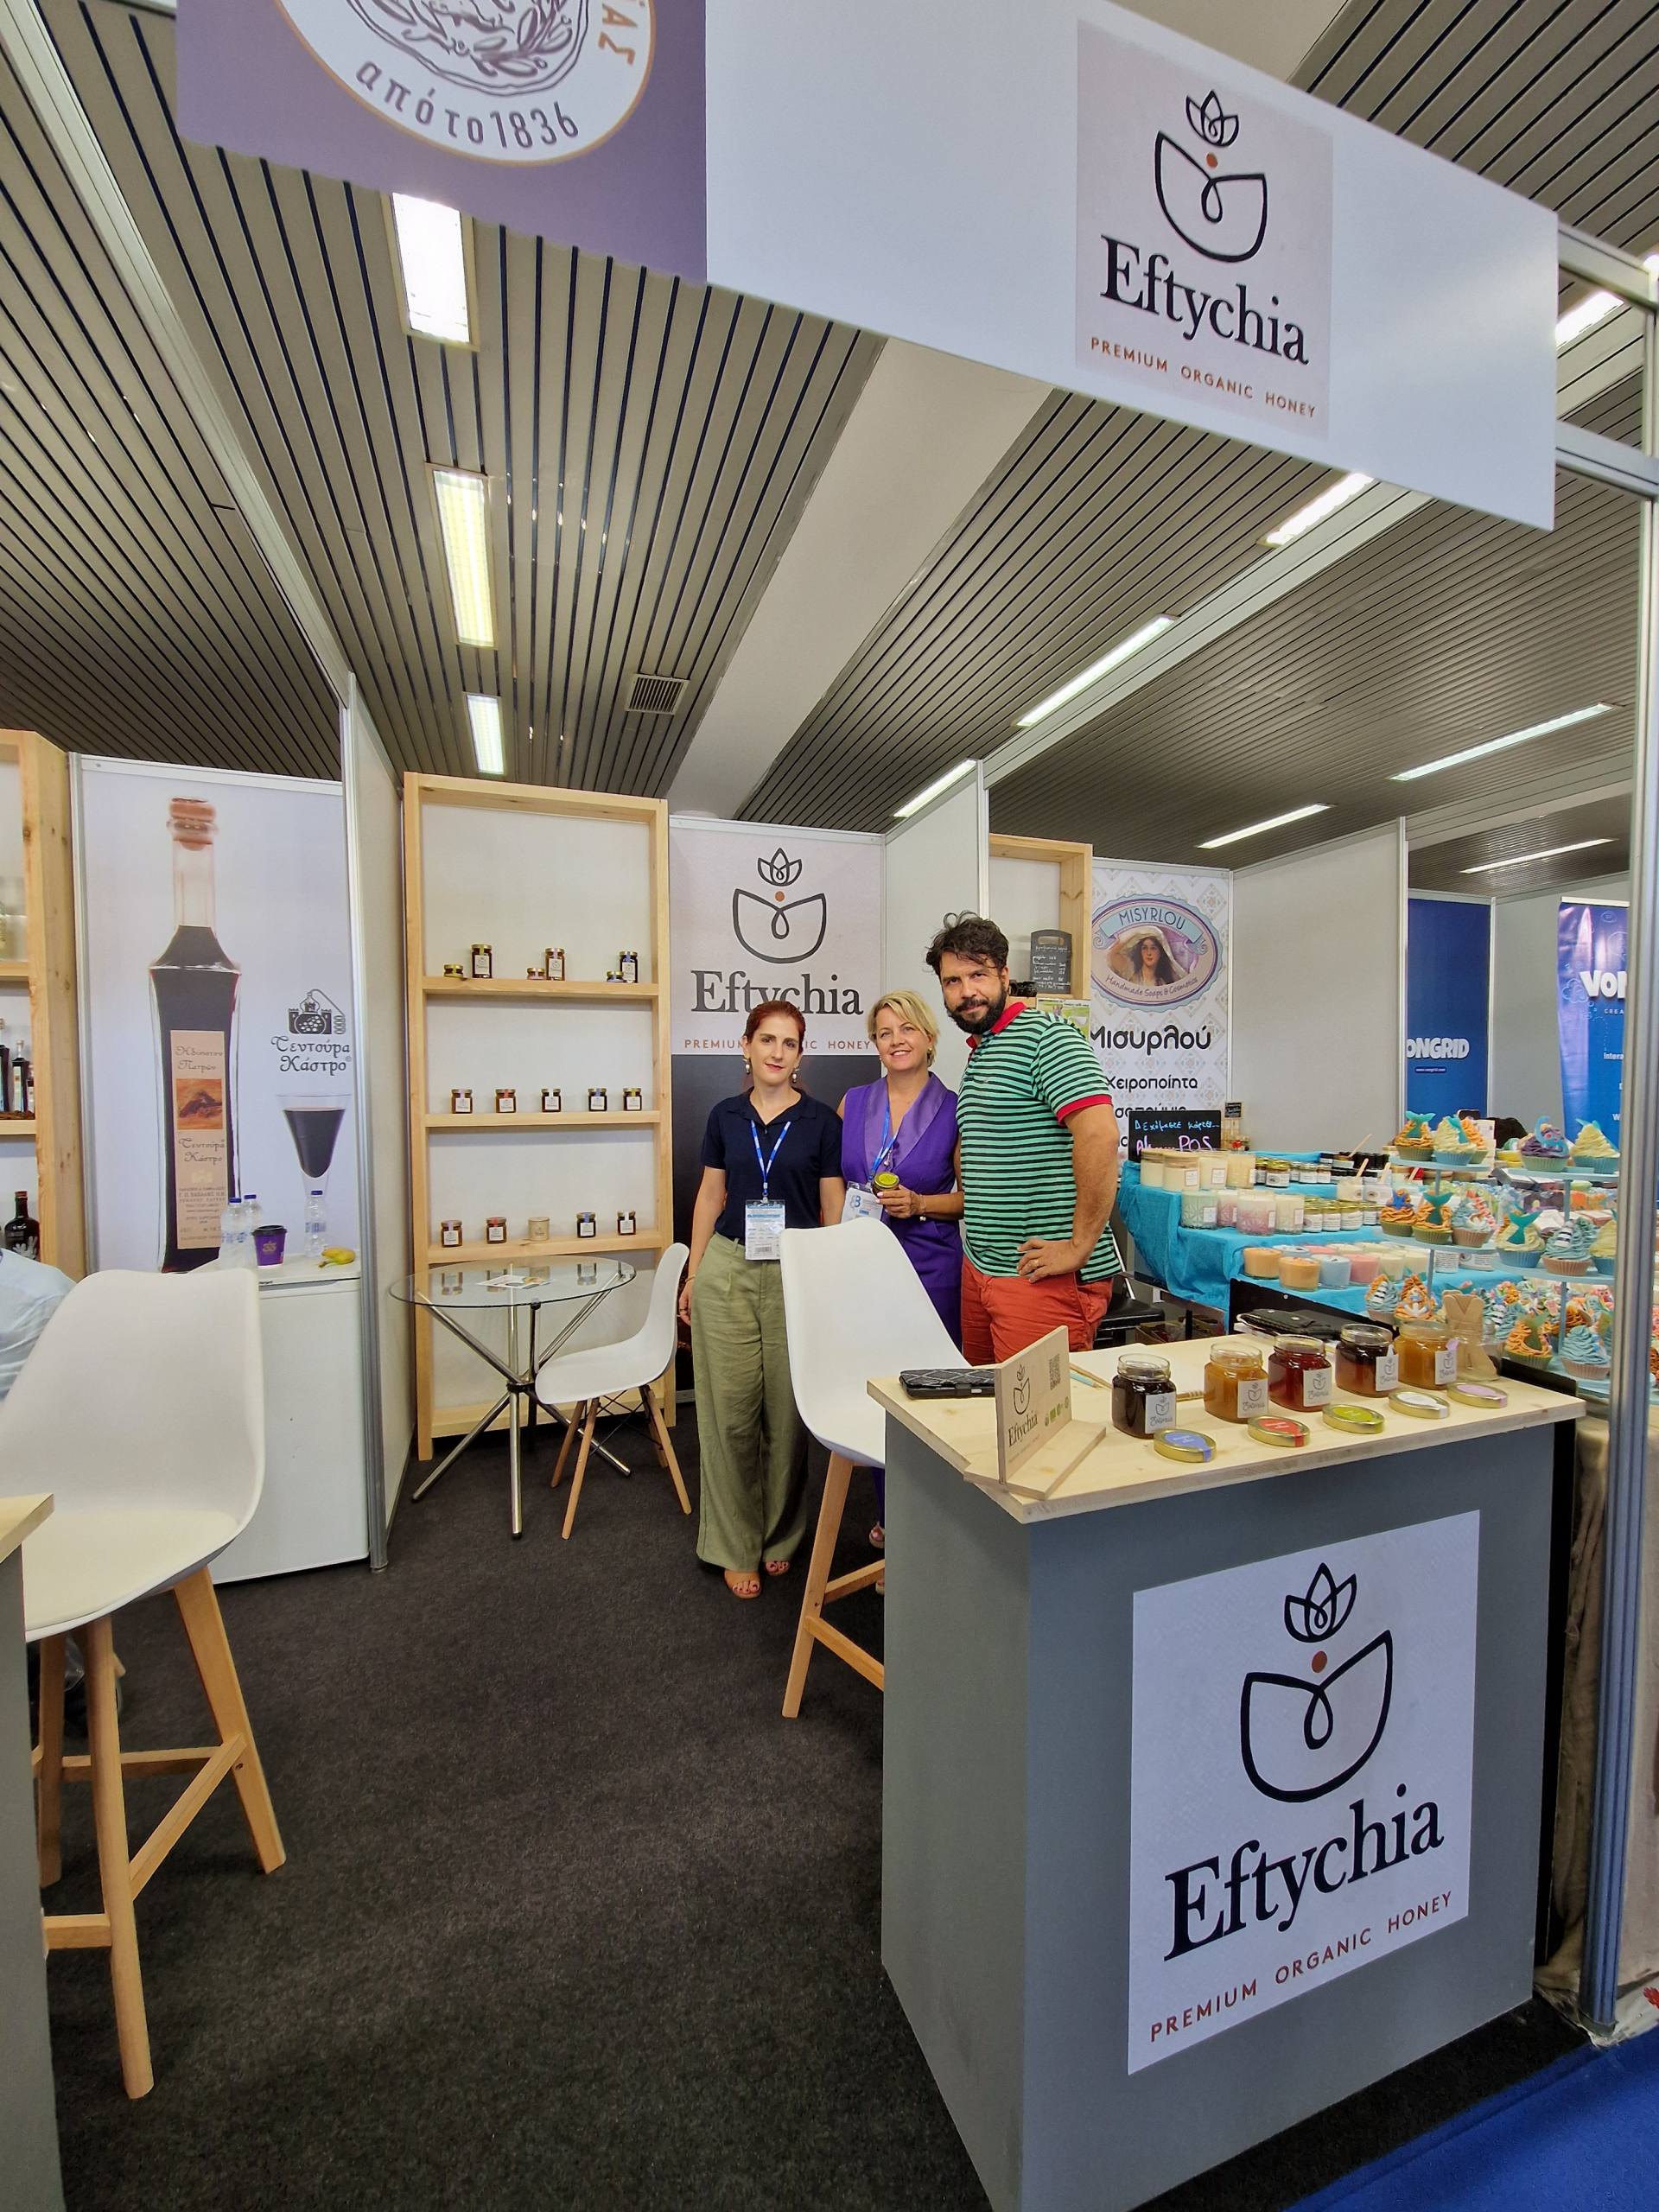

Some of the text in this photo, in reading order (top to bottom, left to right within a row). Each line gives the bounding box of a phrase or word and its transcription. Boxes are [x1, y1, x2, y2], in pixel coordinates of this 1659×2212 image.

[1100, 234, 1310, 365] Eftychia
[1090, 336, 1317, 418] PREMIUM ORGANIC HONEY
[1119, 907, 1186, 930] MISYRLOU
[1105, 974, 1143, 996] Handmade
[1144, 988, 1163, 999] Soaps
[270, 1035, 350, 1058] Τεντούρα
[828, 1039, 870, 1050] HONEY
[1090, 1024, 1211, 1056] Μισυρλού
[279, 1054, 346, 1077] Κάστρο
[1106, 1074, 1198, 1093] Χειροποίητα
[1007, 1409, 1039, 1448] Eftychia
[1163, 1783, 1445, 1962] Eftychia
[1150, 1891, 1454, 2043] PREMIUM ORGANIC HONEY
